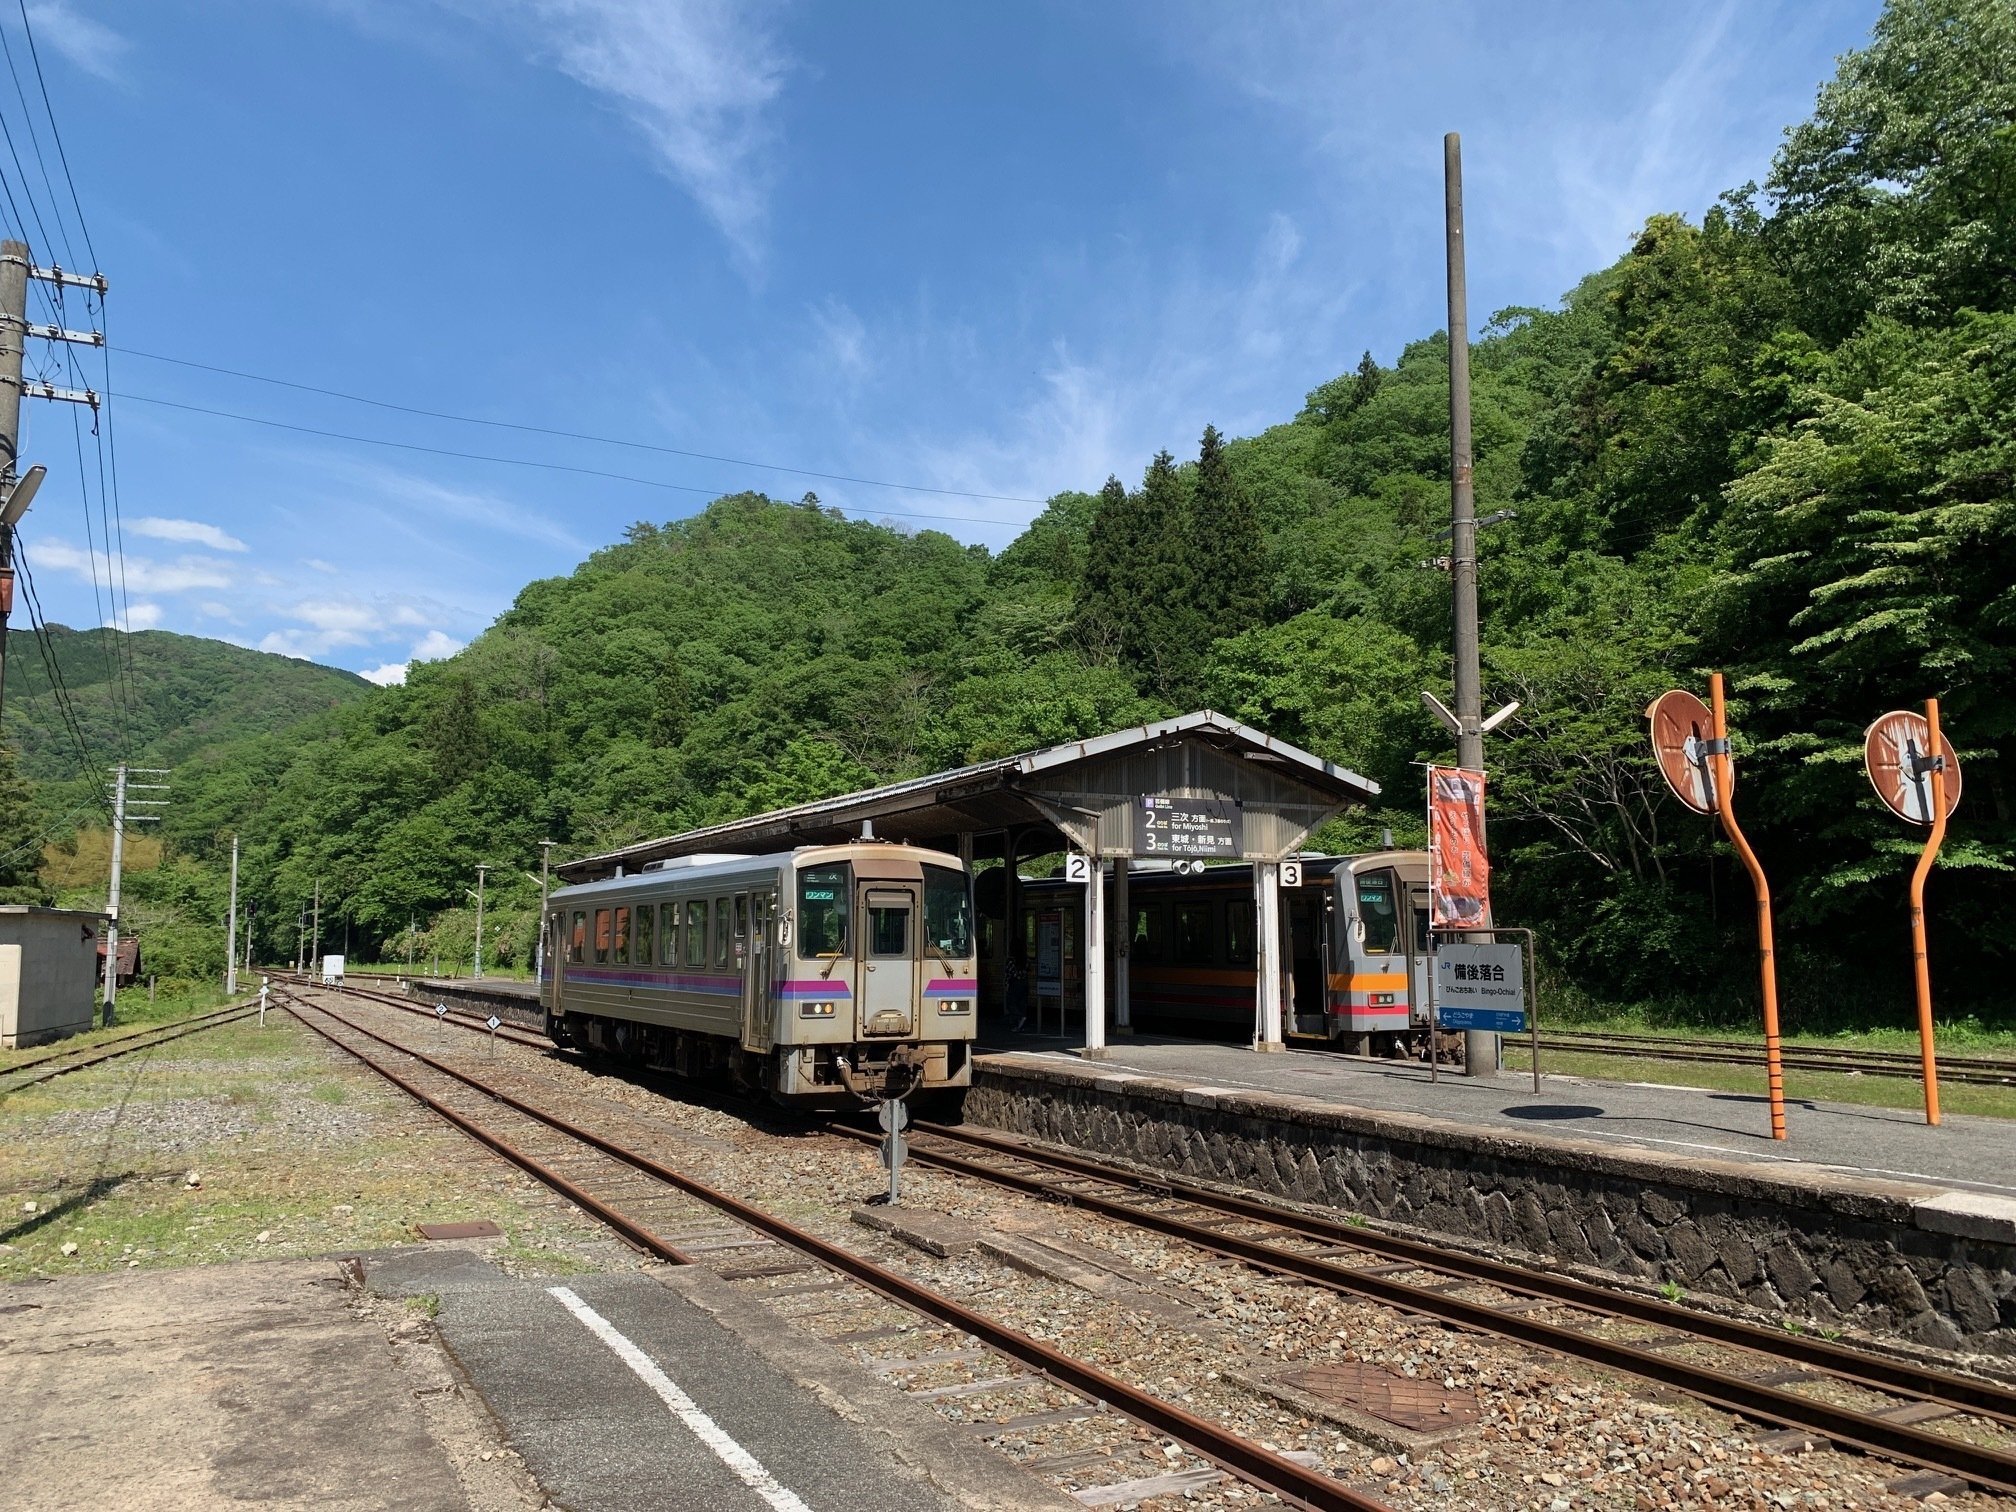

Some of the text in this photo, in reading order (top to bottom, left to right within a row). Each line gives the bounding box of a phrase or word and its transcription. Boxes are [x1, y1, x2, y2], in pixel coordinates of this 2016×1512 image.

[1146, 811, 1156, 828] 2
[1171, 812, 1189, 822] 三次
[1191, 814, 1206, 823] 方面
[1172, 822, 1208, 831] for Miyoshi
[1146, 833, 1156, 850] 3
[1217, 838, 1232, 846] 方面
[1172, 844, 1182, 852] for
[1072, 859, 1085, 878] 2
[1285, 866, 1297, 884] 3
[1441, 962, 1451, 970] JR
[1454, 964, 1504, 981] 備後落合
[1481, 987, 1515, 996] Bingo-Ochiai
